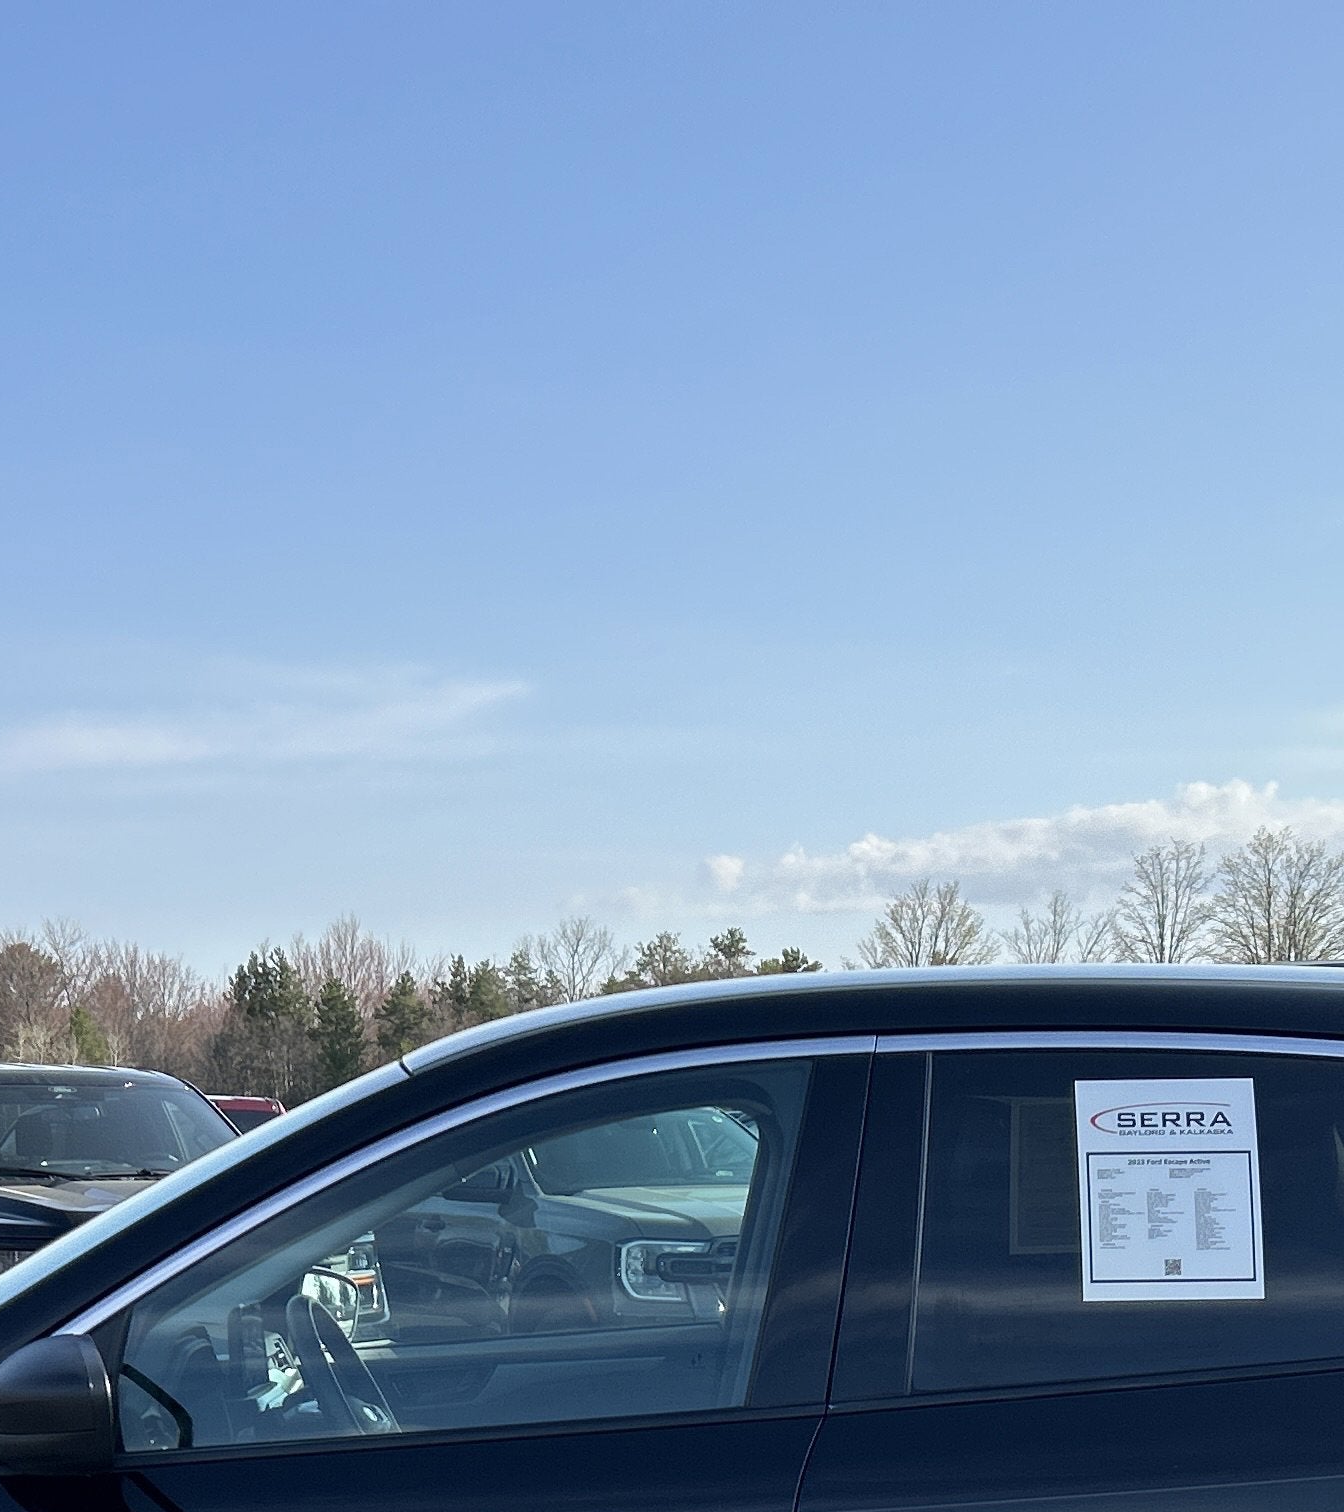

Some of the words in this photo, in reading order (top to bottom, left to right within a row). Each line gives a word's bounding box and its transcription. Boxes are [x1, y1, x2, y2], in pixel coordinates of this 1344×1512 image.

[1117, 1111, 1232, 1128] SERRA
[1118, 1129, 1166, 1137] GAYLORD
[1179, 1128, 1234, 1136] KALKASKA
[1146, 1158, 1163, 1166] Ford
[1164, 1158, 1188, 1166] Escape
[1189, 1157, 1211, 1165] Active
